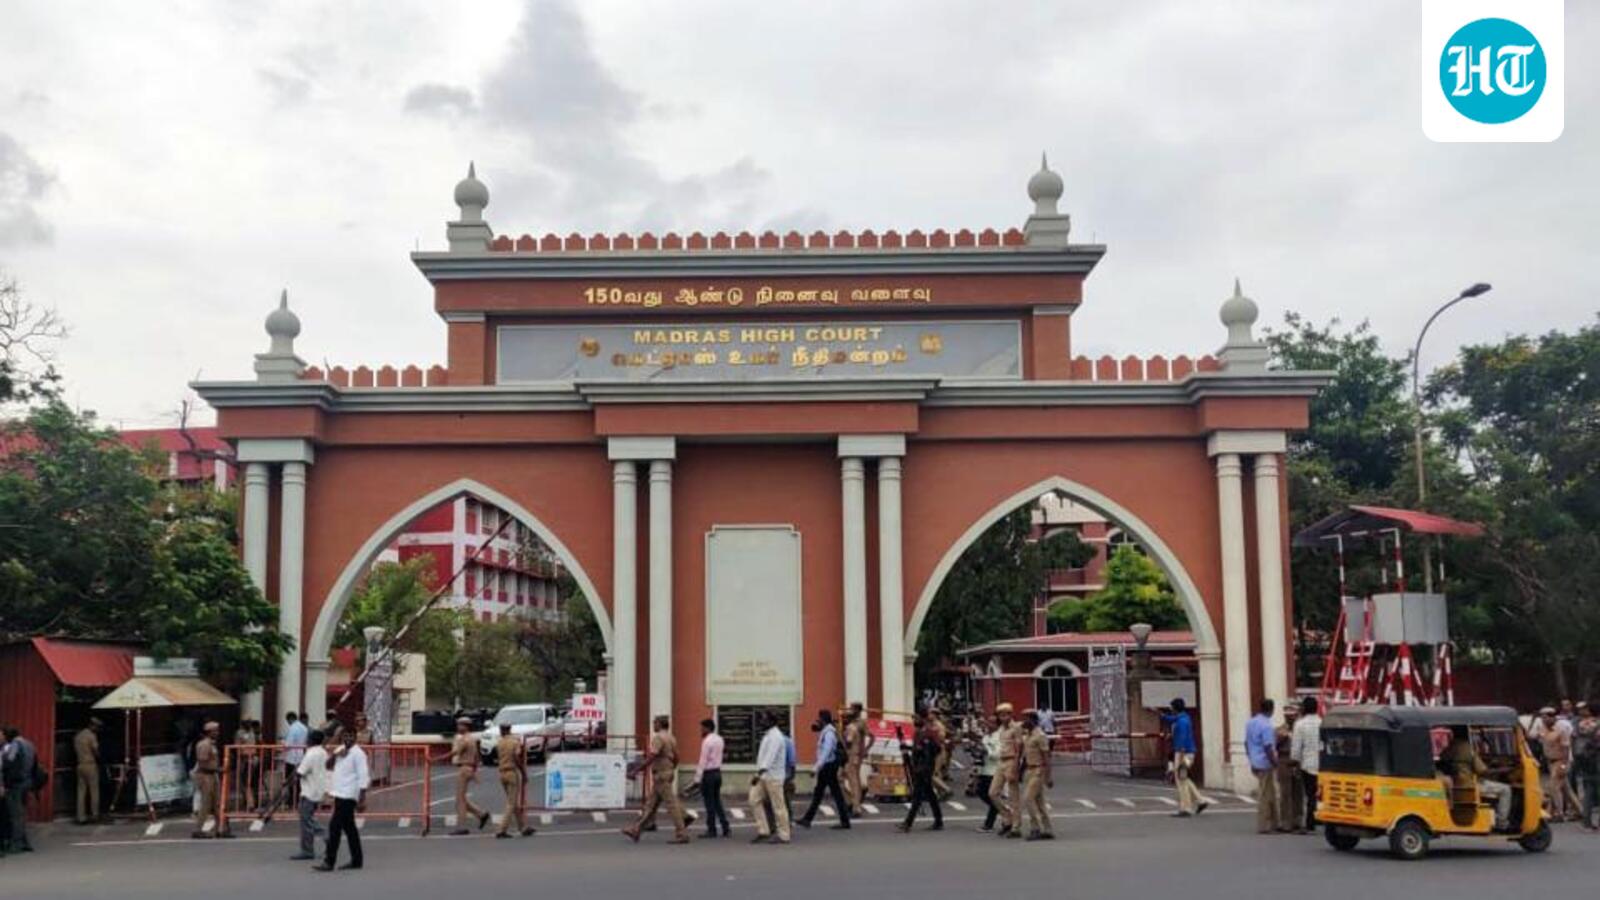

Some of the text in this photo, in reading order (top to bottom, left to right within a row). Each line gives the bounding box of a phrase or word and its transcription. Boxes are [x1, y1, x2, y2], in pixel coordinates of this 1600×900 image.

[584, 286, 932, 307] 150வது ஆண்டு நினைவு வளைவு
[633, 327, 882, 343] MADRAS HIGH COURT
